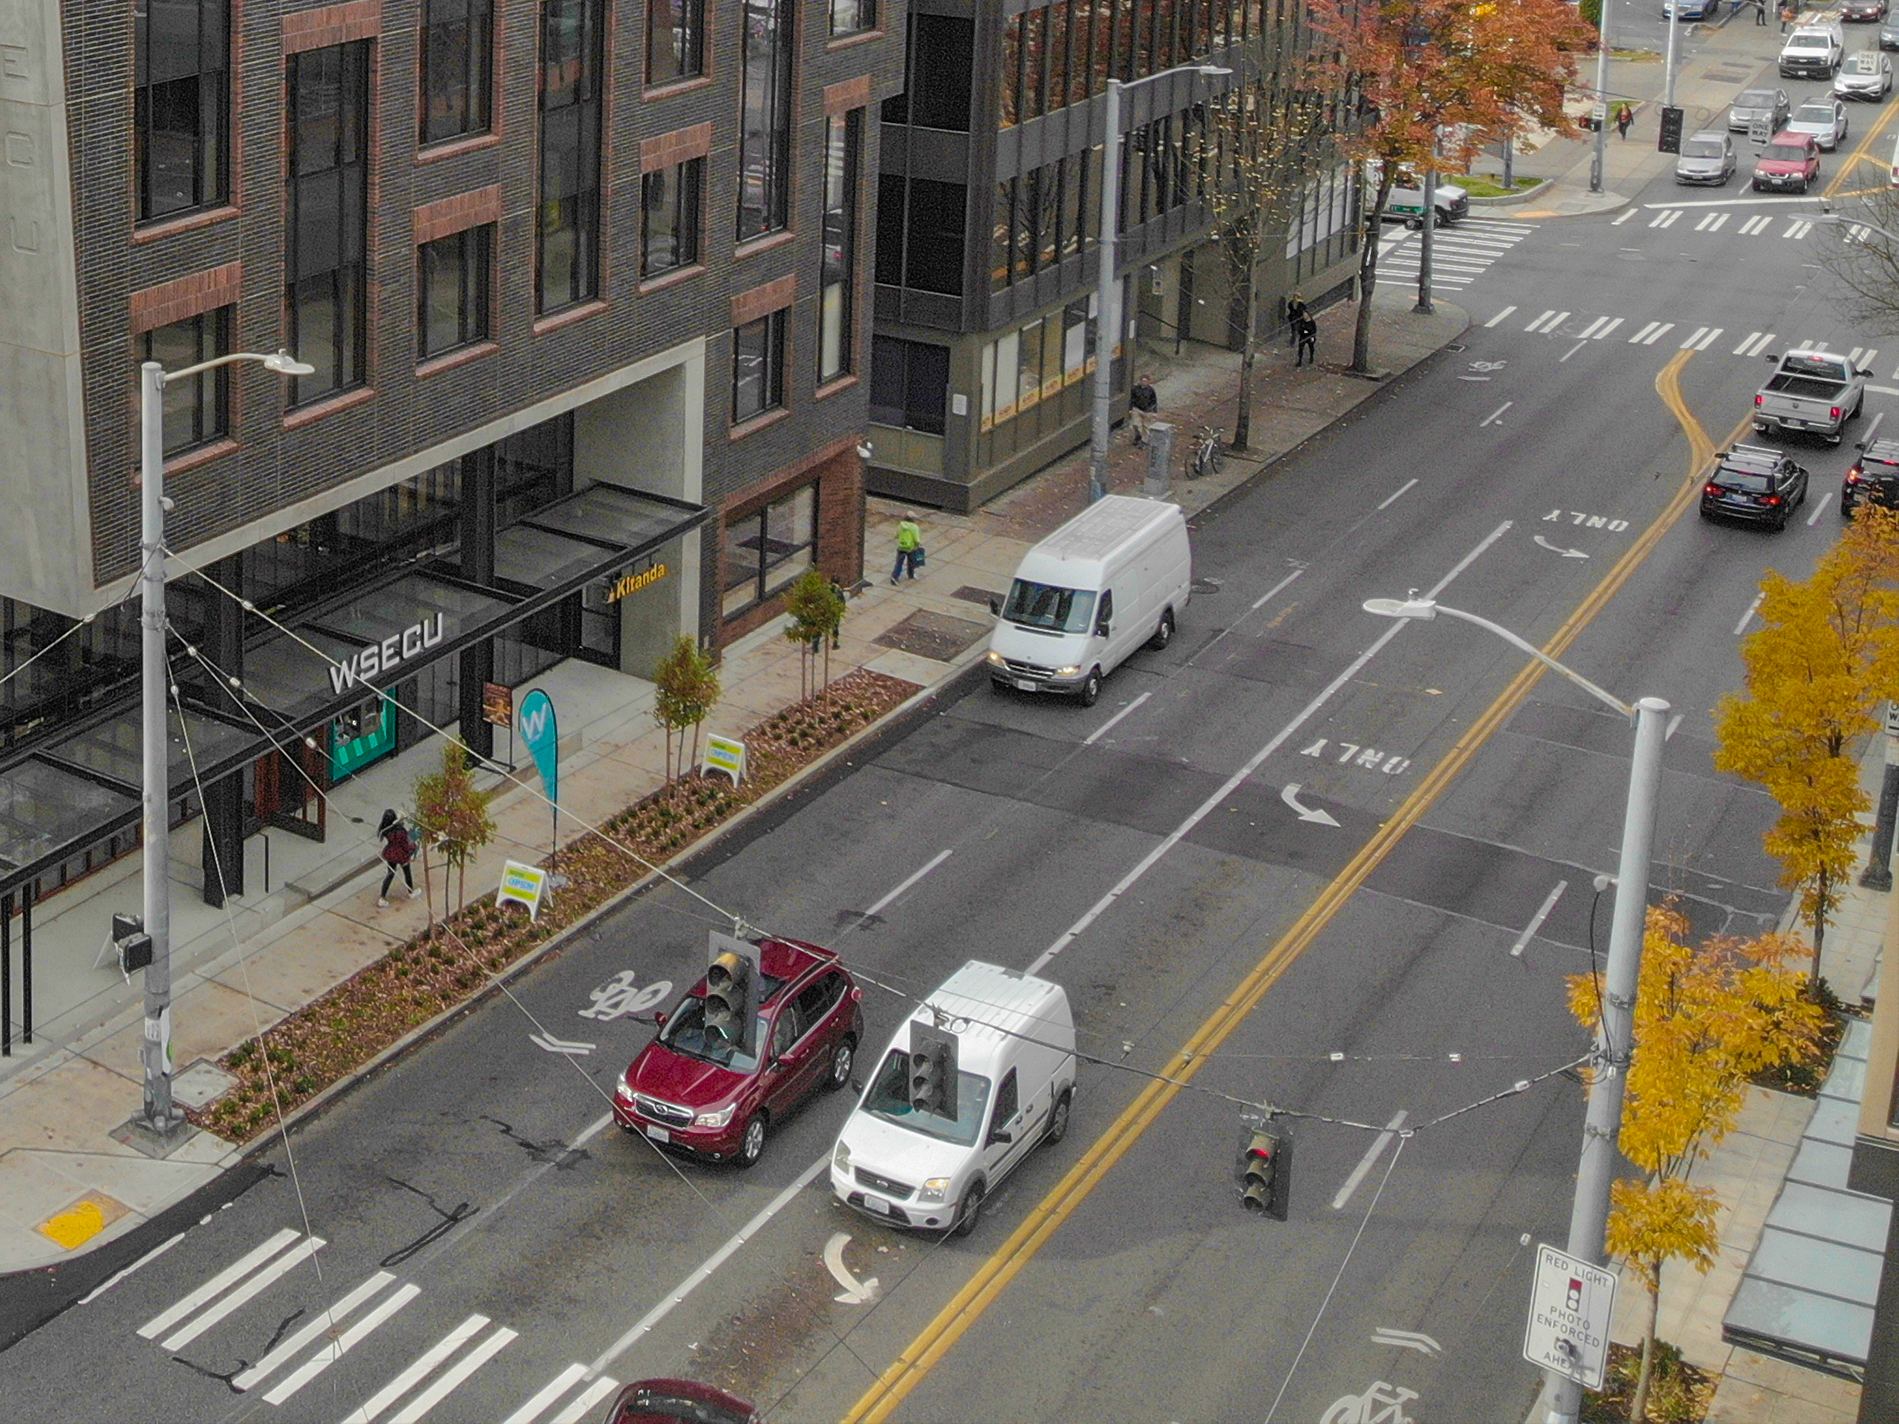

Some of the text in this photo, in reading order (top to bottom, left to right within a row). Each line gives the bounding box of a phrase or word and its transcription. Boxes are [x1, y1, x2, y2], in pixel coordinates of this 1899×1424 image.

[1751, 130, 1769, 138] WAY
[1542, 510, 1629, 533] ONLY
[329, 611, 443, 695] WSECU
[1301, 739, 1411, 775] ONLY
[1546, 1253, 1609, 1288] RED LIGHT
[1536, 1313, 1600, 1349] ENFORCED
[1549, 1305, 1591, 1331] PHOTO
